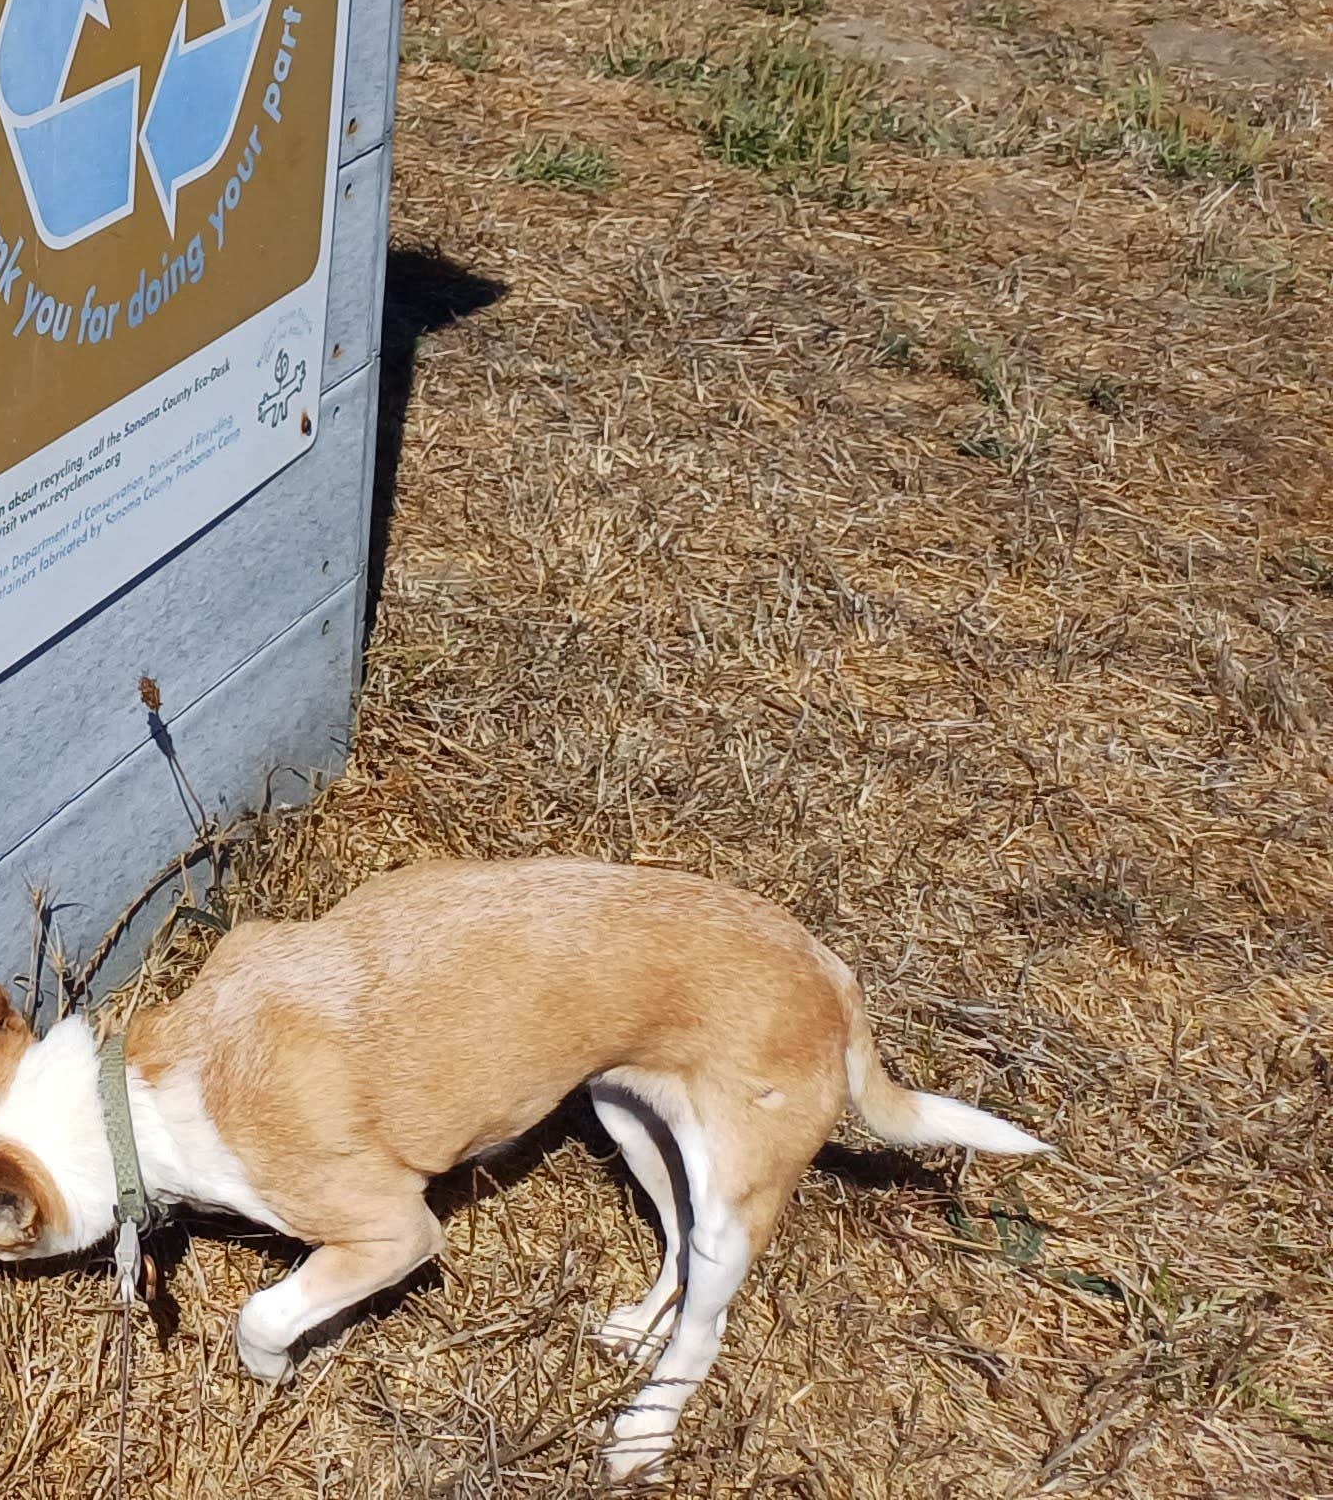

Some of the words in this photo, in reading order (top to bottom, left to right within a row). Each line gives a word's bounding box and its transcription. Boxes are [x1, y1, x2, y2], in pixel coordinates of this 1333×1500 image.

[12, 281, 72, 342] you
[77, 284, 121, 344] for
[127, 232, 206, 329] doing
[207, 124, 262, 251] your
[262, 5, 302, 124] part
[8, 482, 37, 511] about
[40, 456, 85, 491] recycling,
[88, 435, 105, 461] call
[107, 430, 122, 448] the
[124, 407, 160, 438] Sonoma
[162, 386, 192, 412] County
[194, 357, 231, 392] Eco-Desk
[19, 452, 121, 524] www.recyclenow.org
[12, 522, 70, 571] Department
[72, 510, 82, 530] of
[39, 526, 87, 573] fabricated
[90, 522, 102, 539] by
[105, 496, 141, 524] Sonoma
